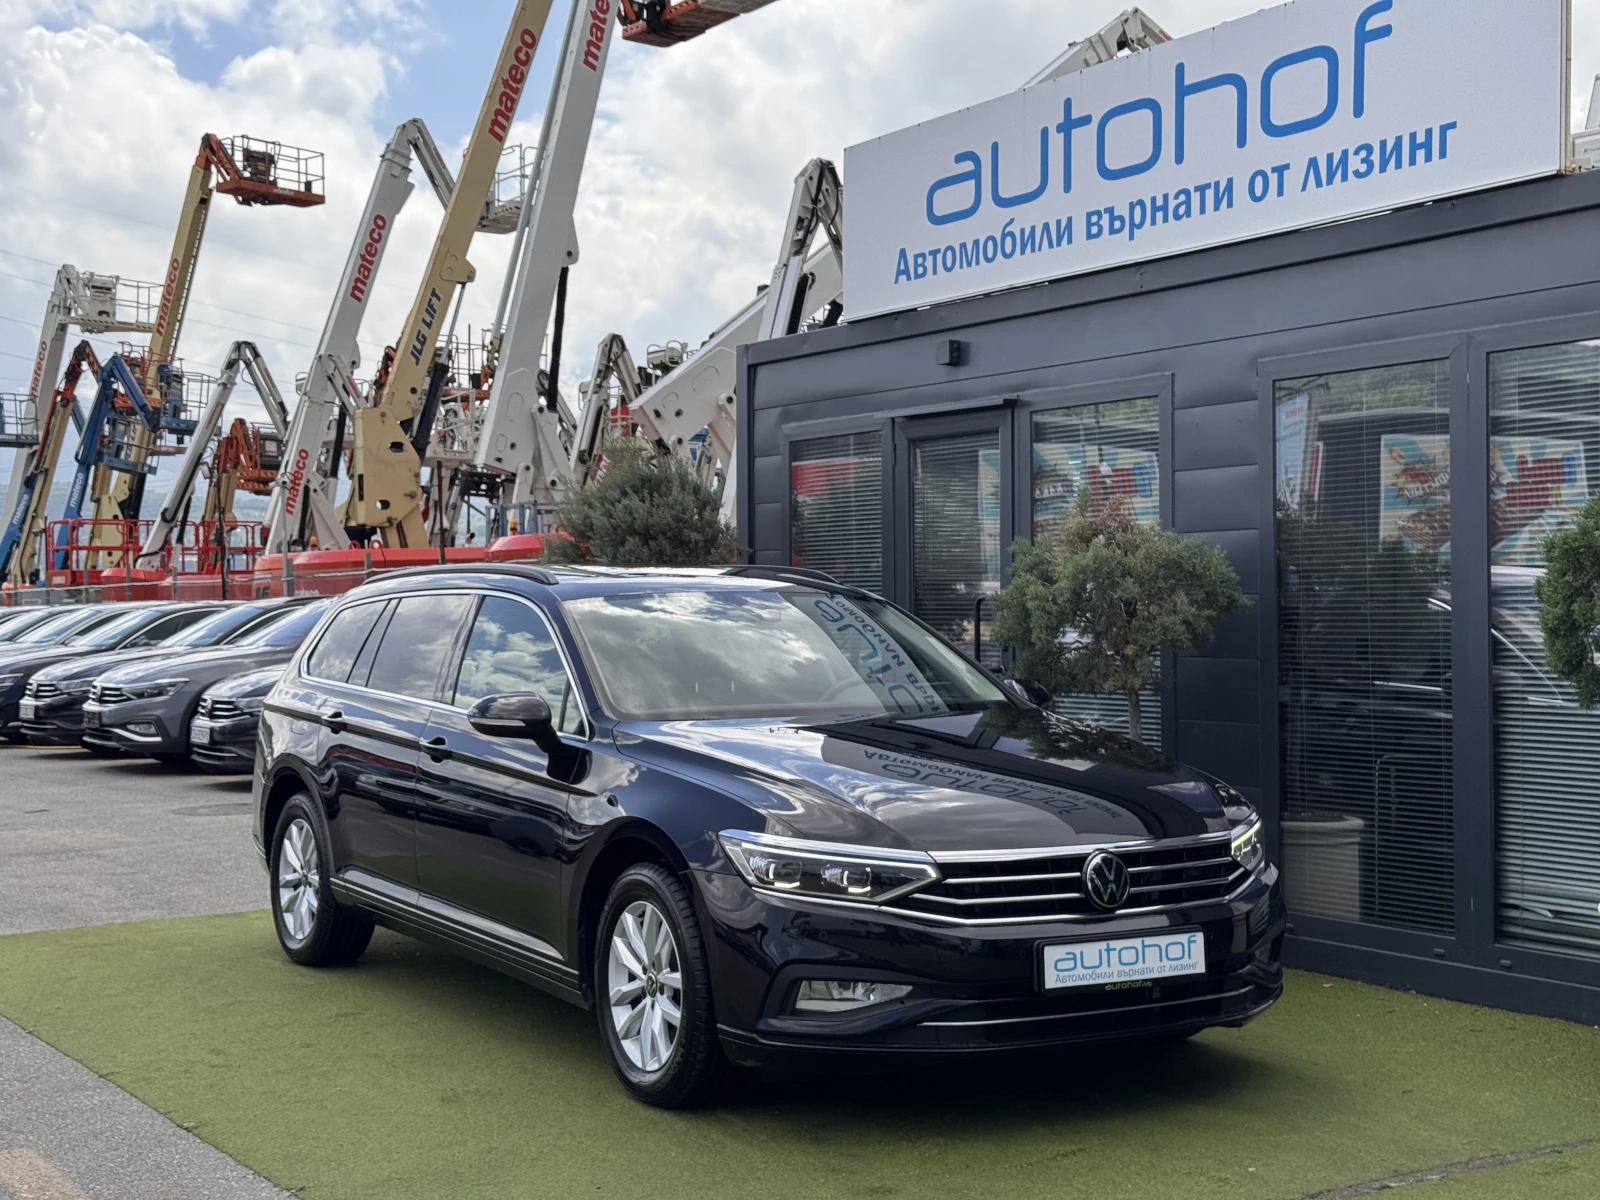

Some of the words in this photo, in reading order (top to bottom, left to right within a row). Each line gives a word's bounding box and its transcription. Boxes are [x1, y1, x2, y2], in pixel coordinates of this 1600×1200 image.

[488, 27, 537, 143] mateco
[926, 0, 1393, 226] autohof
[894, 213, 1073, 285] Автомобили
[1085, 175, 1234, 246] върнати
[1247, 162, 1292, 203] от
[1300, 120, 1458, 193] лизинг
[155, 257, 181, 337] mateco
[350, 213, 387, 304] mateco
[409, 327, 429, 367] JLG
[422, 287, 443, 331] LIFT
[12, 493, 29, 526] mateco
[69, 471, 84, 509] mateco
[284, 448, 310, 515] mateco
[1053, 934, 1198, 973] autohof
[1054, 969, 1115, 985] Автомобили
[1117, 964, 1155, 979] върнати
[1156, 963, 1167, 974] от
[1168, 960, 1199, 973] лизинг
